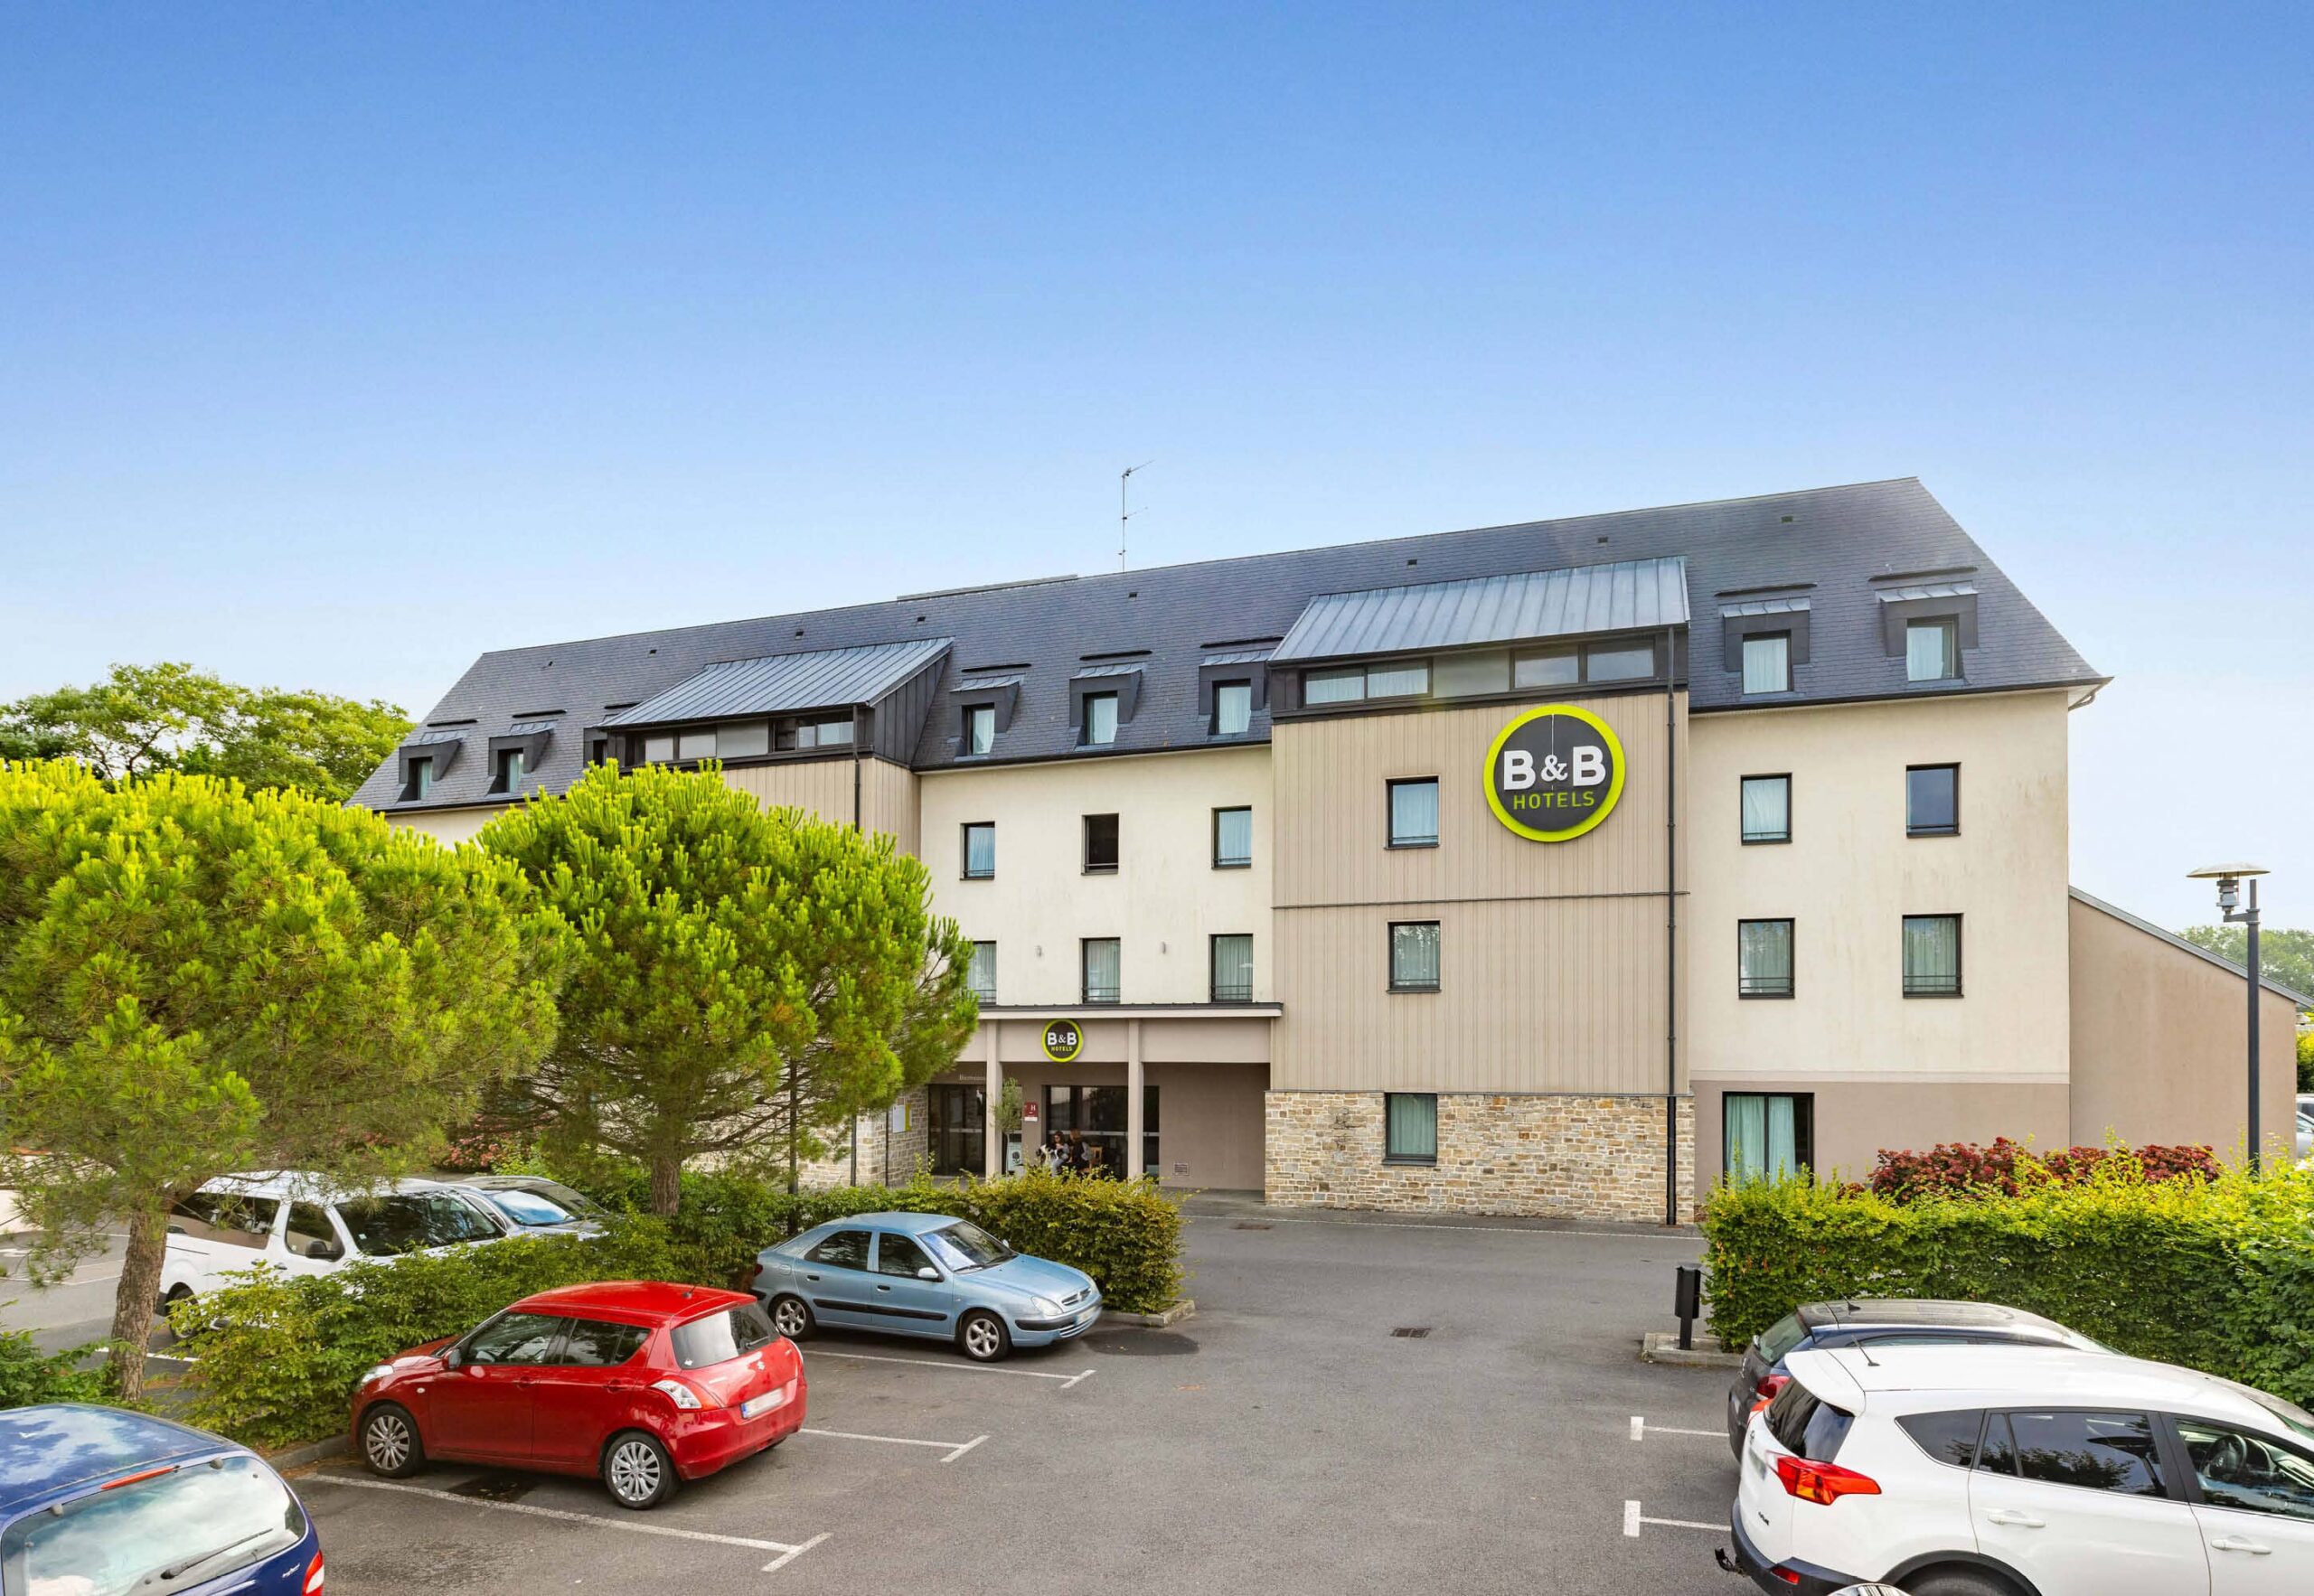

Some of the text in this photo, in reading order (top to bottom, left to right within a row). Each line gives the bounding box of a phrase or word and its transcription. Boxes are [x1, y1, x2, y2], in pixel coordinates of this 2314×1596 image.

[1504, 746, 1606, 790] B&B
[1513, 792, 1594, 810] HOTELS
[1048, 1032, 1077, 1045] B&B
